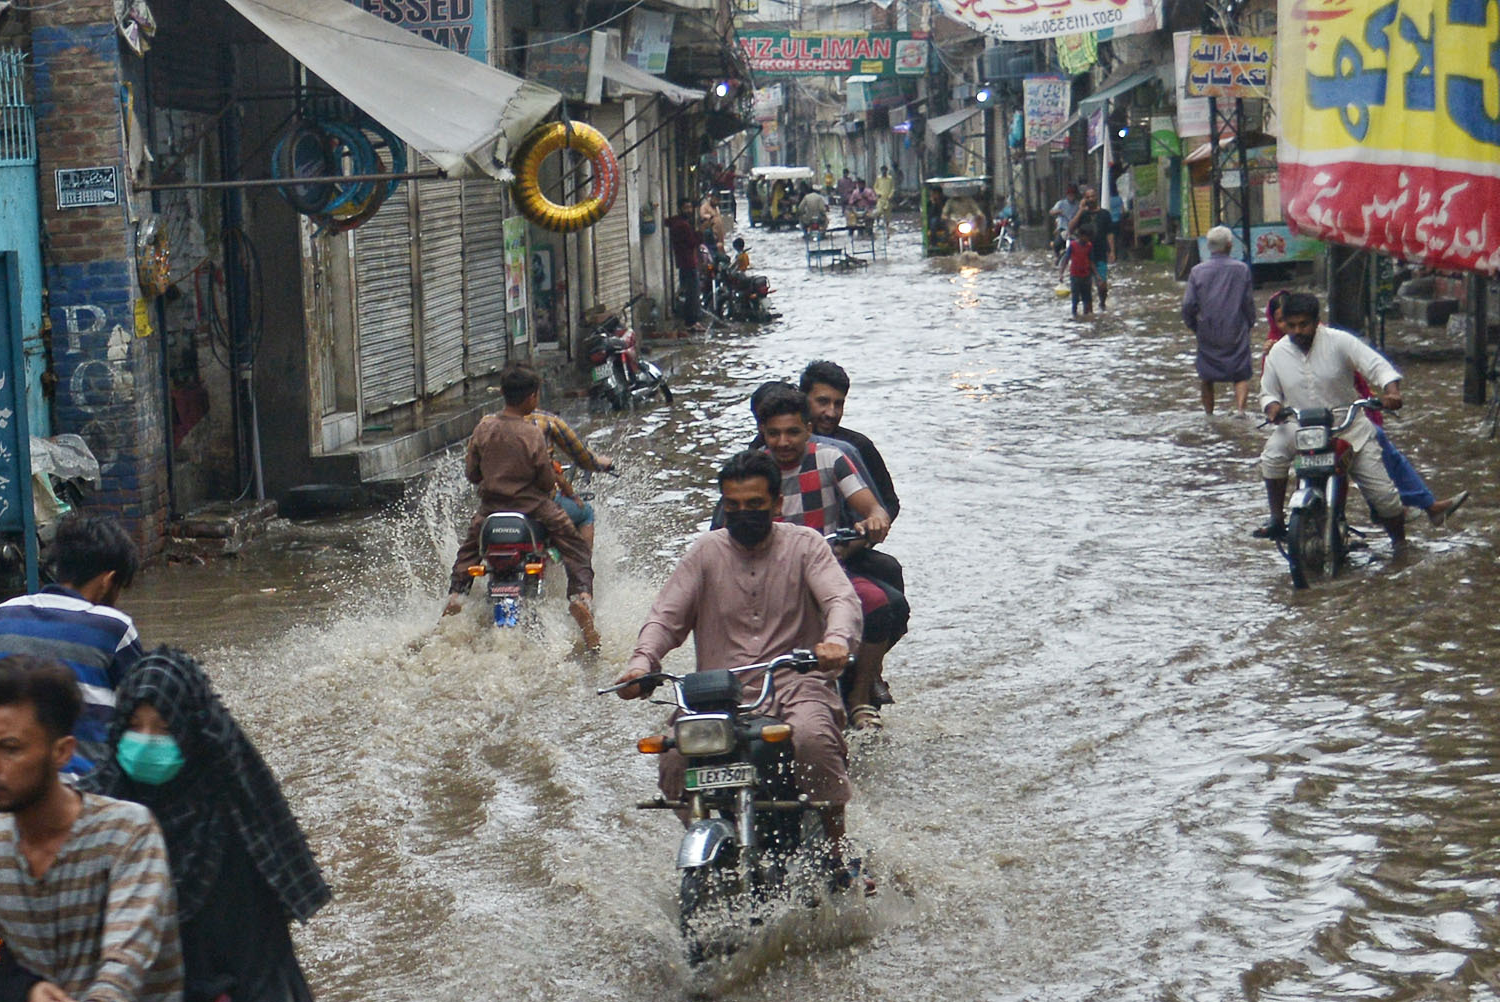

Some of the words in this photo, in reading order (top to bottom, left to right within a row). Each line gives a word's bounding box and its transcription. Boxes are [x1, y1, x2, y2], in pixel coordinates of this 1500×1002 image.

[352, 0, 474, 24] ESSED
[798, 59, 851, 70] SCHOOL
[1192, 67, 1232, 92] شاپ
[492, 527, 521, 535] HONDA
